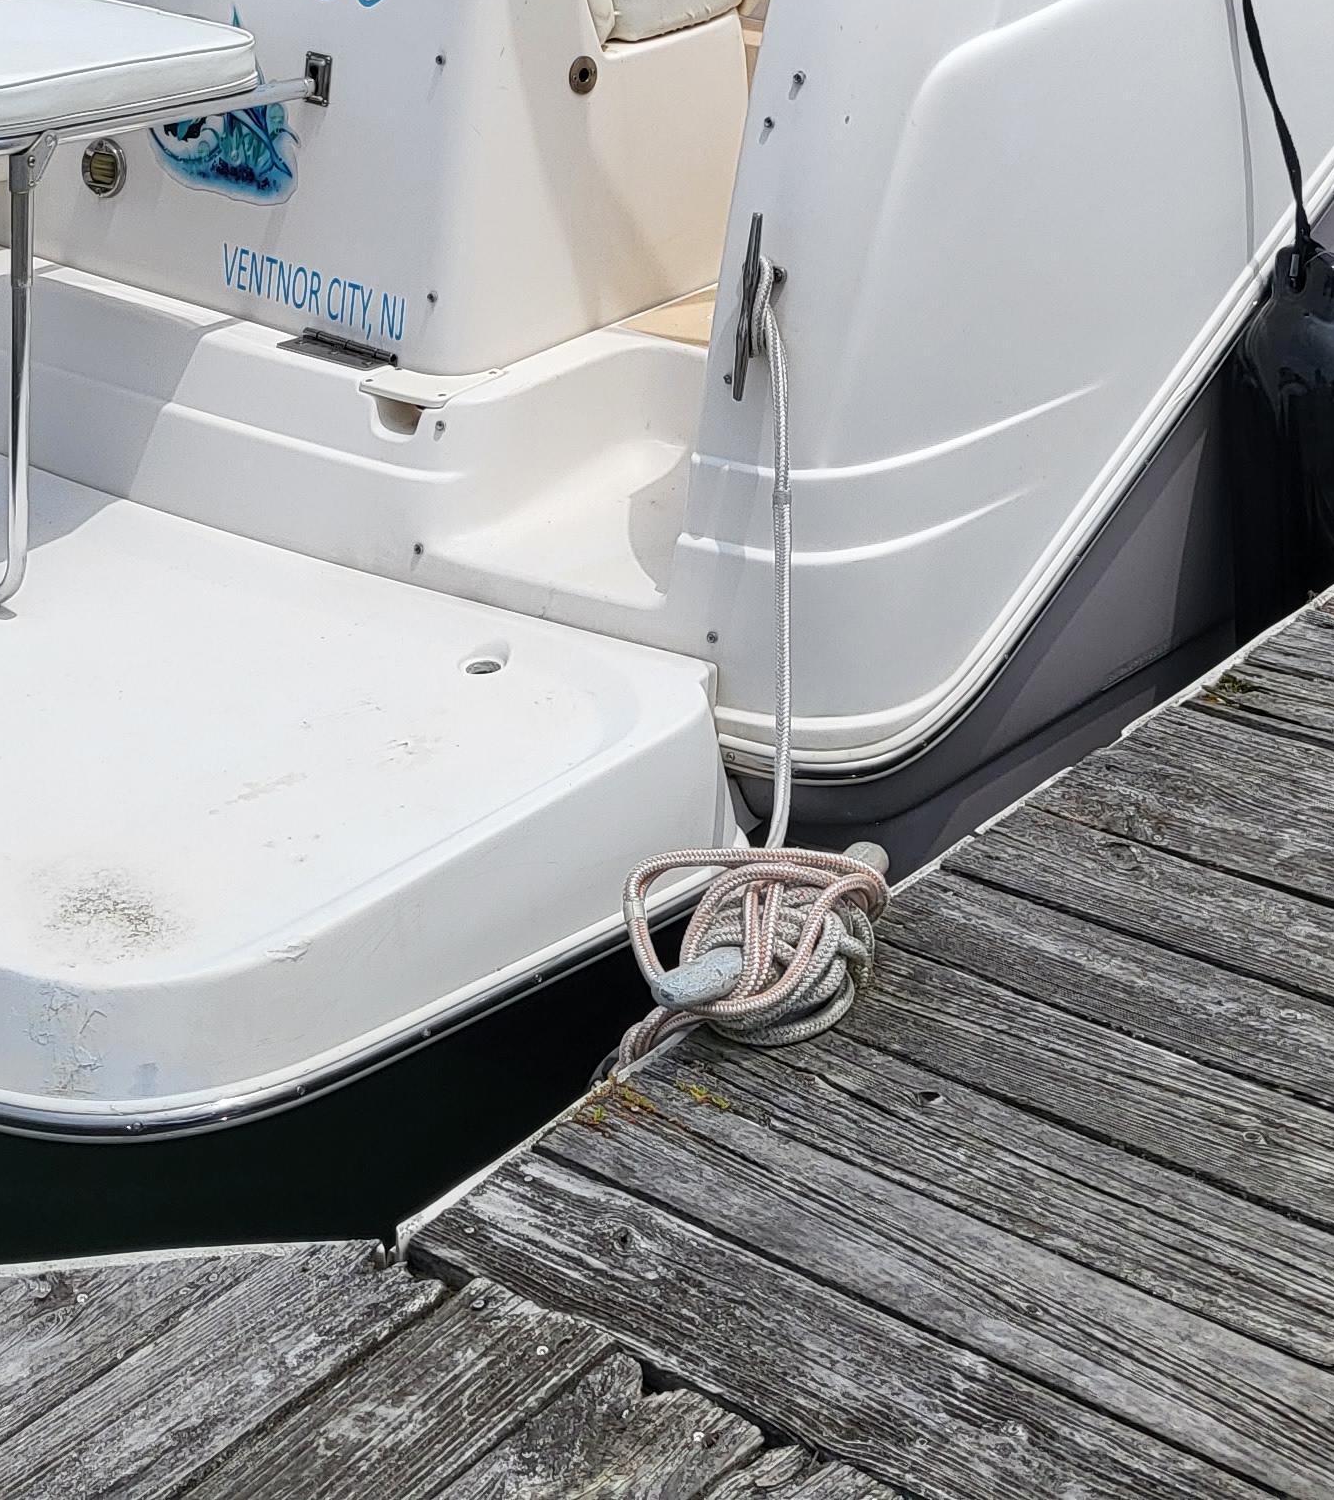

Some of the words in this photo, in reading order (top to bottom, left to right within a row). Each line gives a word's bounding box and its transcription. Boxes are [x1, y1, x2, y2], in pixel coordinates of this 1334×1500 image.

[223, 243, 322, 315] VENTNOR
[327, 277, 374, 340] CITY,
[380, 292, 406, 341] NJ
